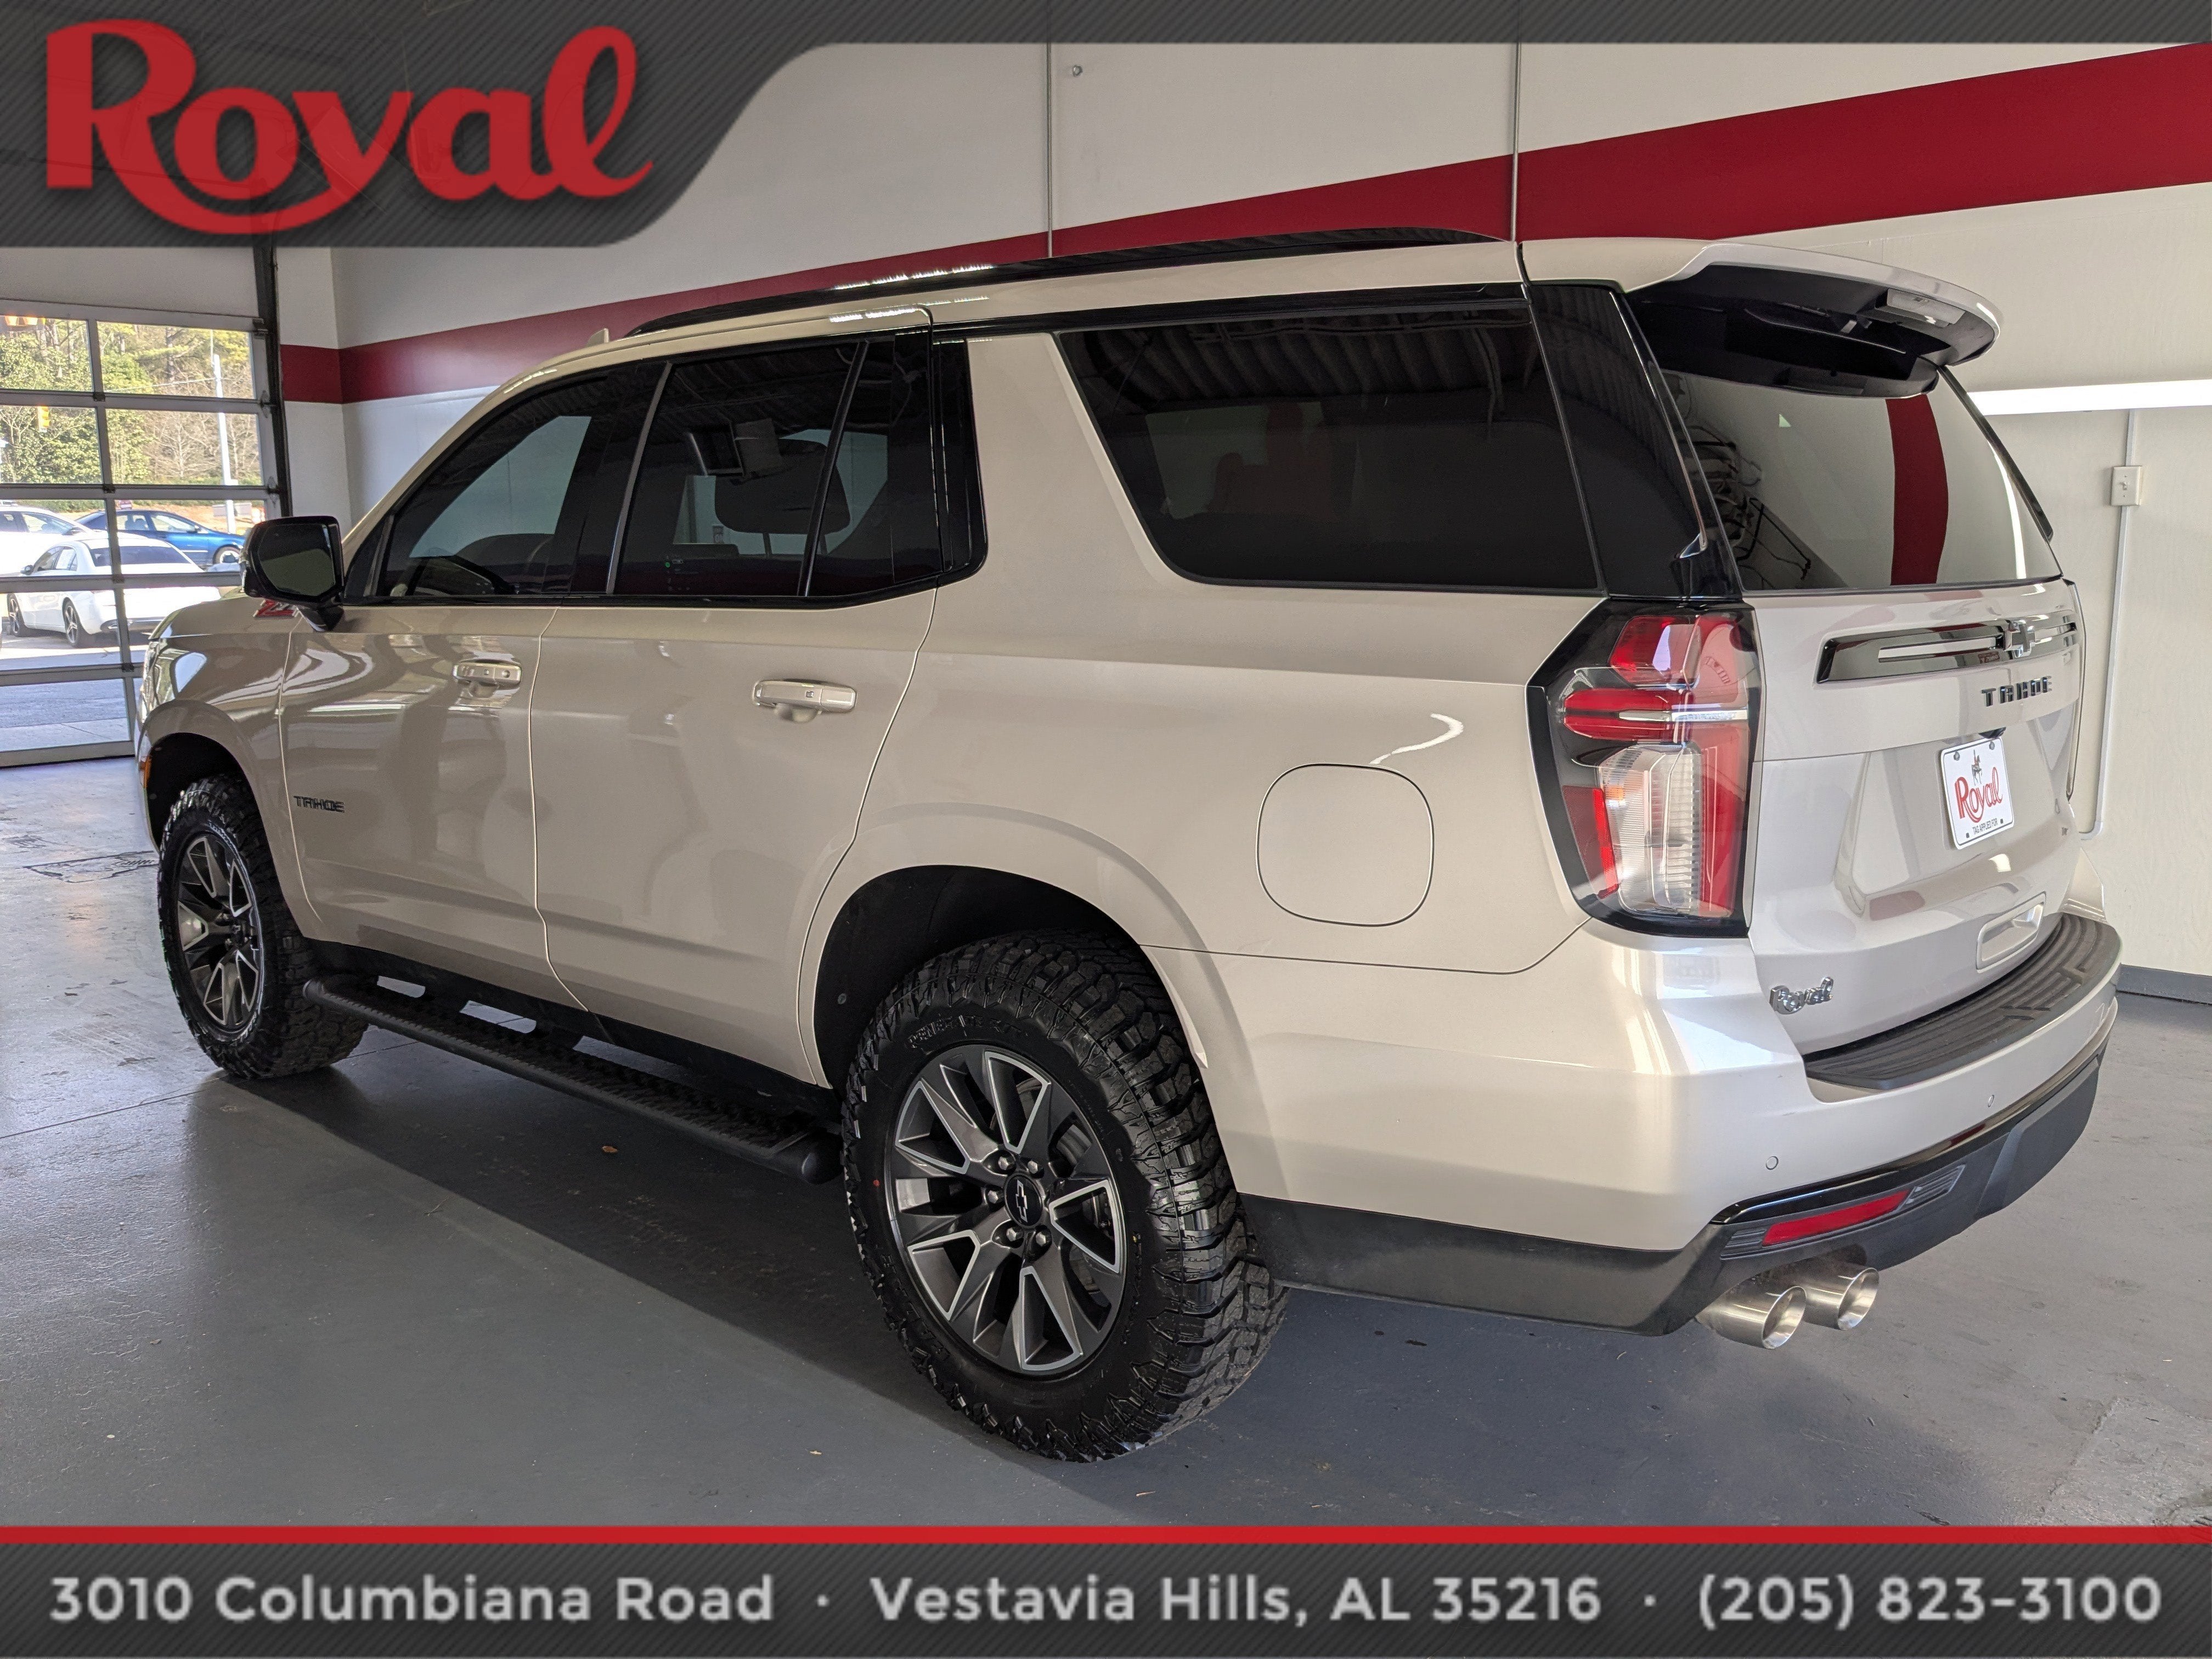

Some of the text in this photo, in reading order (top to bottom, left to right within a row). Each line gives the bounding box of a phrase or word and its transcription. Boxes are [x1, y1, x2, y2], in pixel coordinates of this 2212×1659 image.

[1981, 675, 2052, 707] TAHOE
[294, 795, 345, 813] TAHOE
[1955, 766, 2003, 823] Royal
